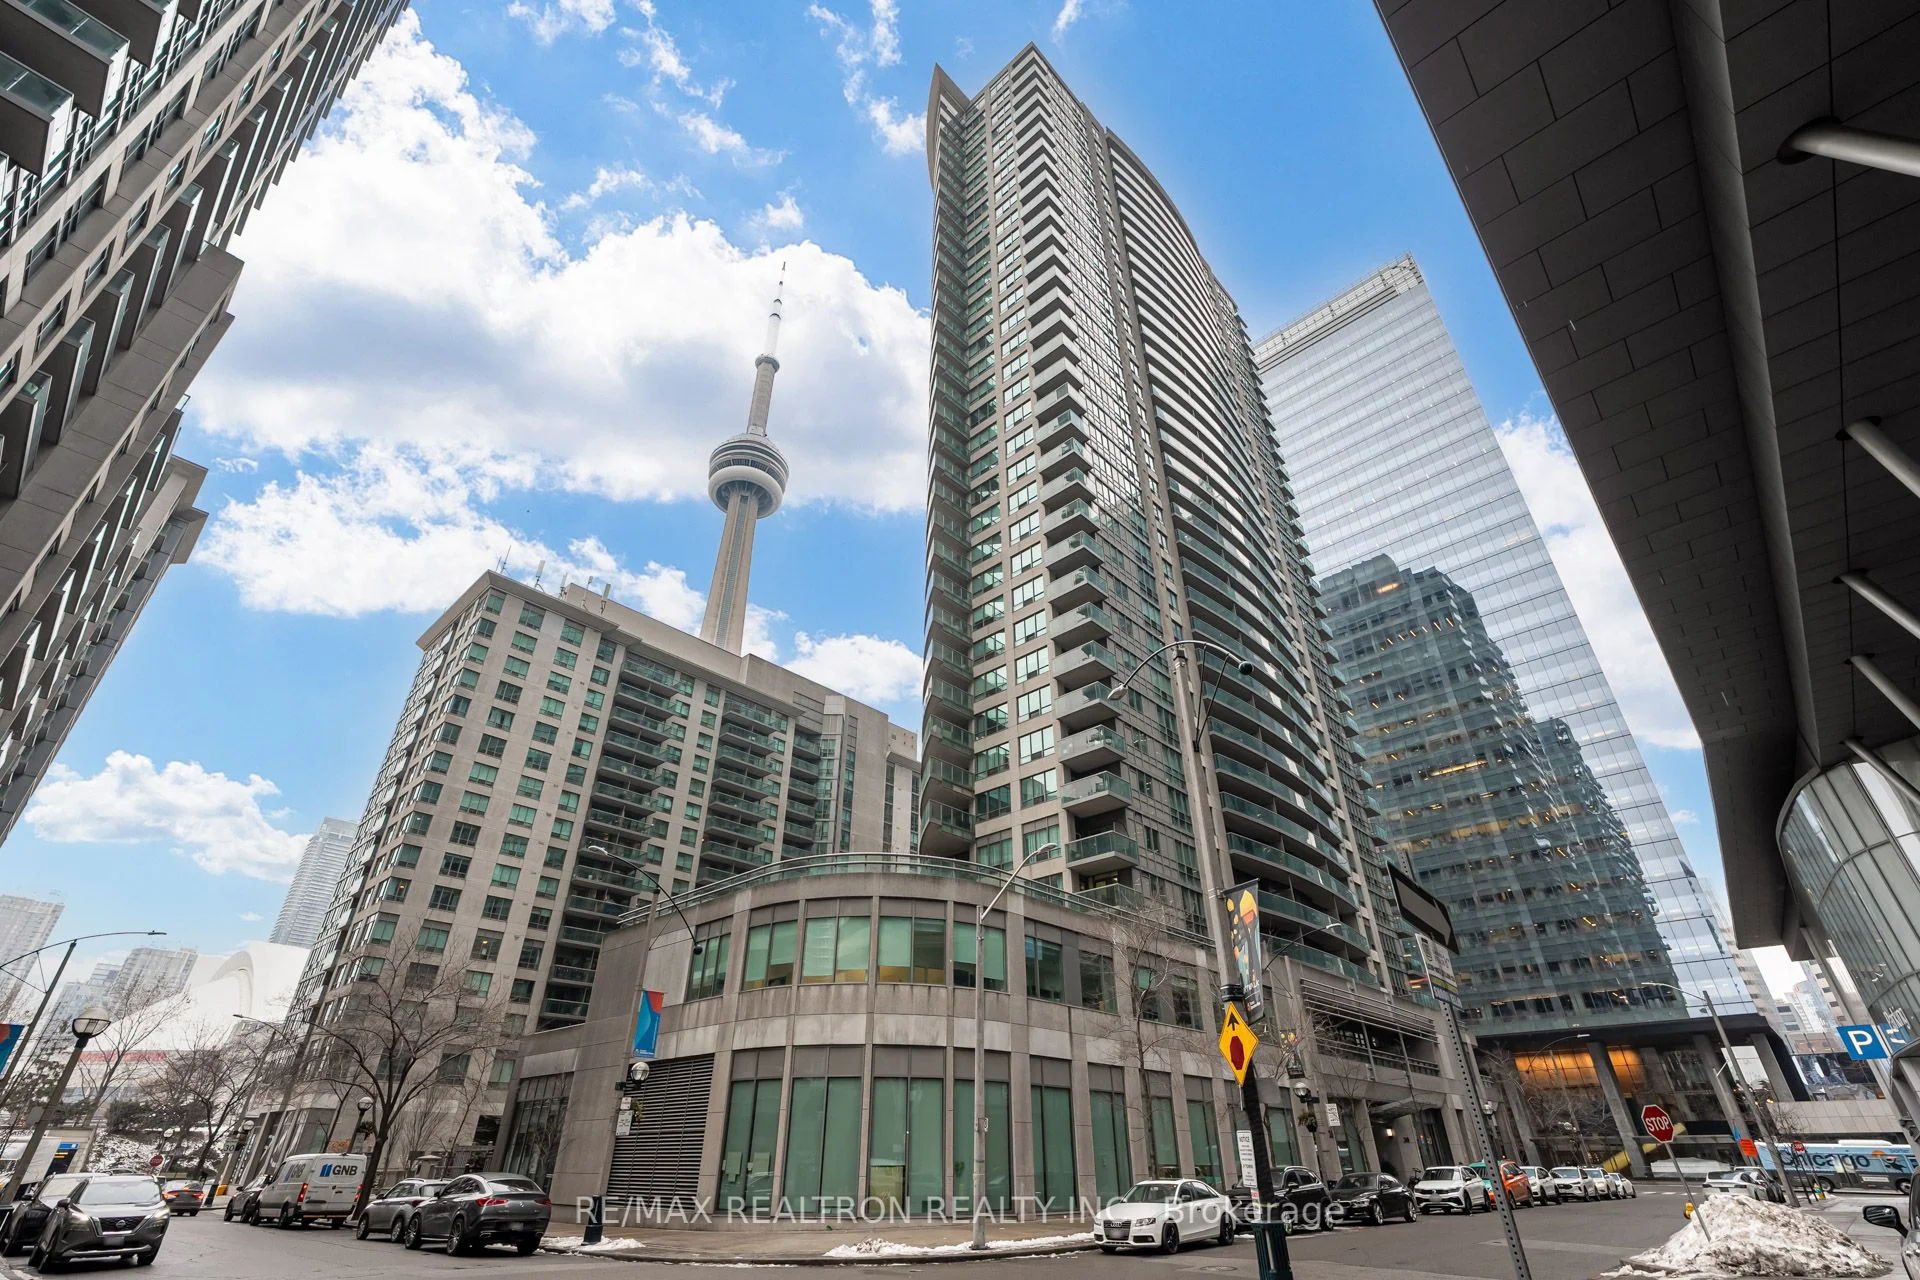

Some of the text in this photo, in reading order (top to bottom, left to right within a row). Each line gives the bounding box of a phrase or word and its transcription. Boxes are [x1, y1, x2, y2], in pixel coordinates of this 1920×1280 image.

[1883, 1006, 1911, 1030] Parking
[1848, 1030, 1873, 1055] P
[1645, 1116, 1670, 1131] STOP
[332, 1165, 358, 1176] GNB
